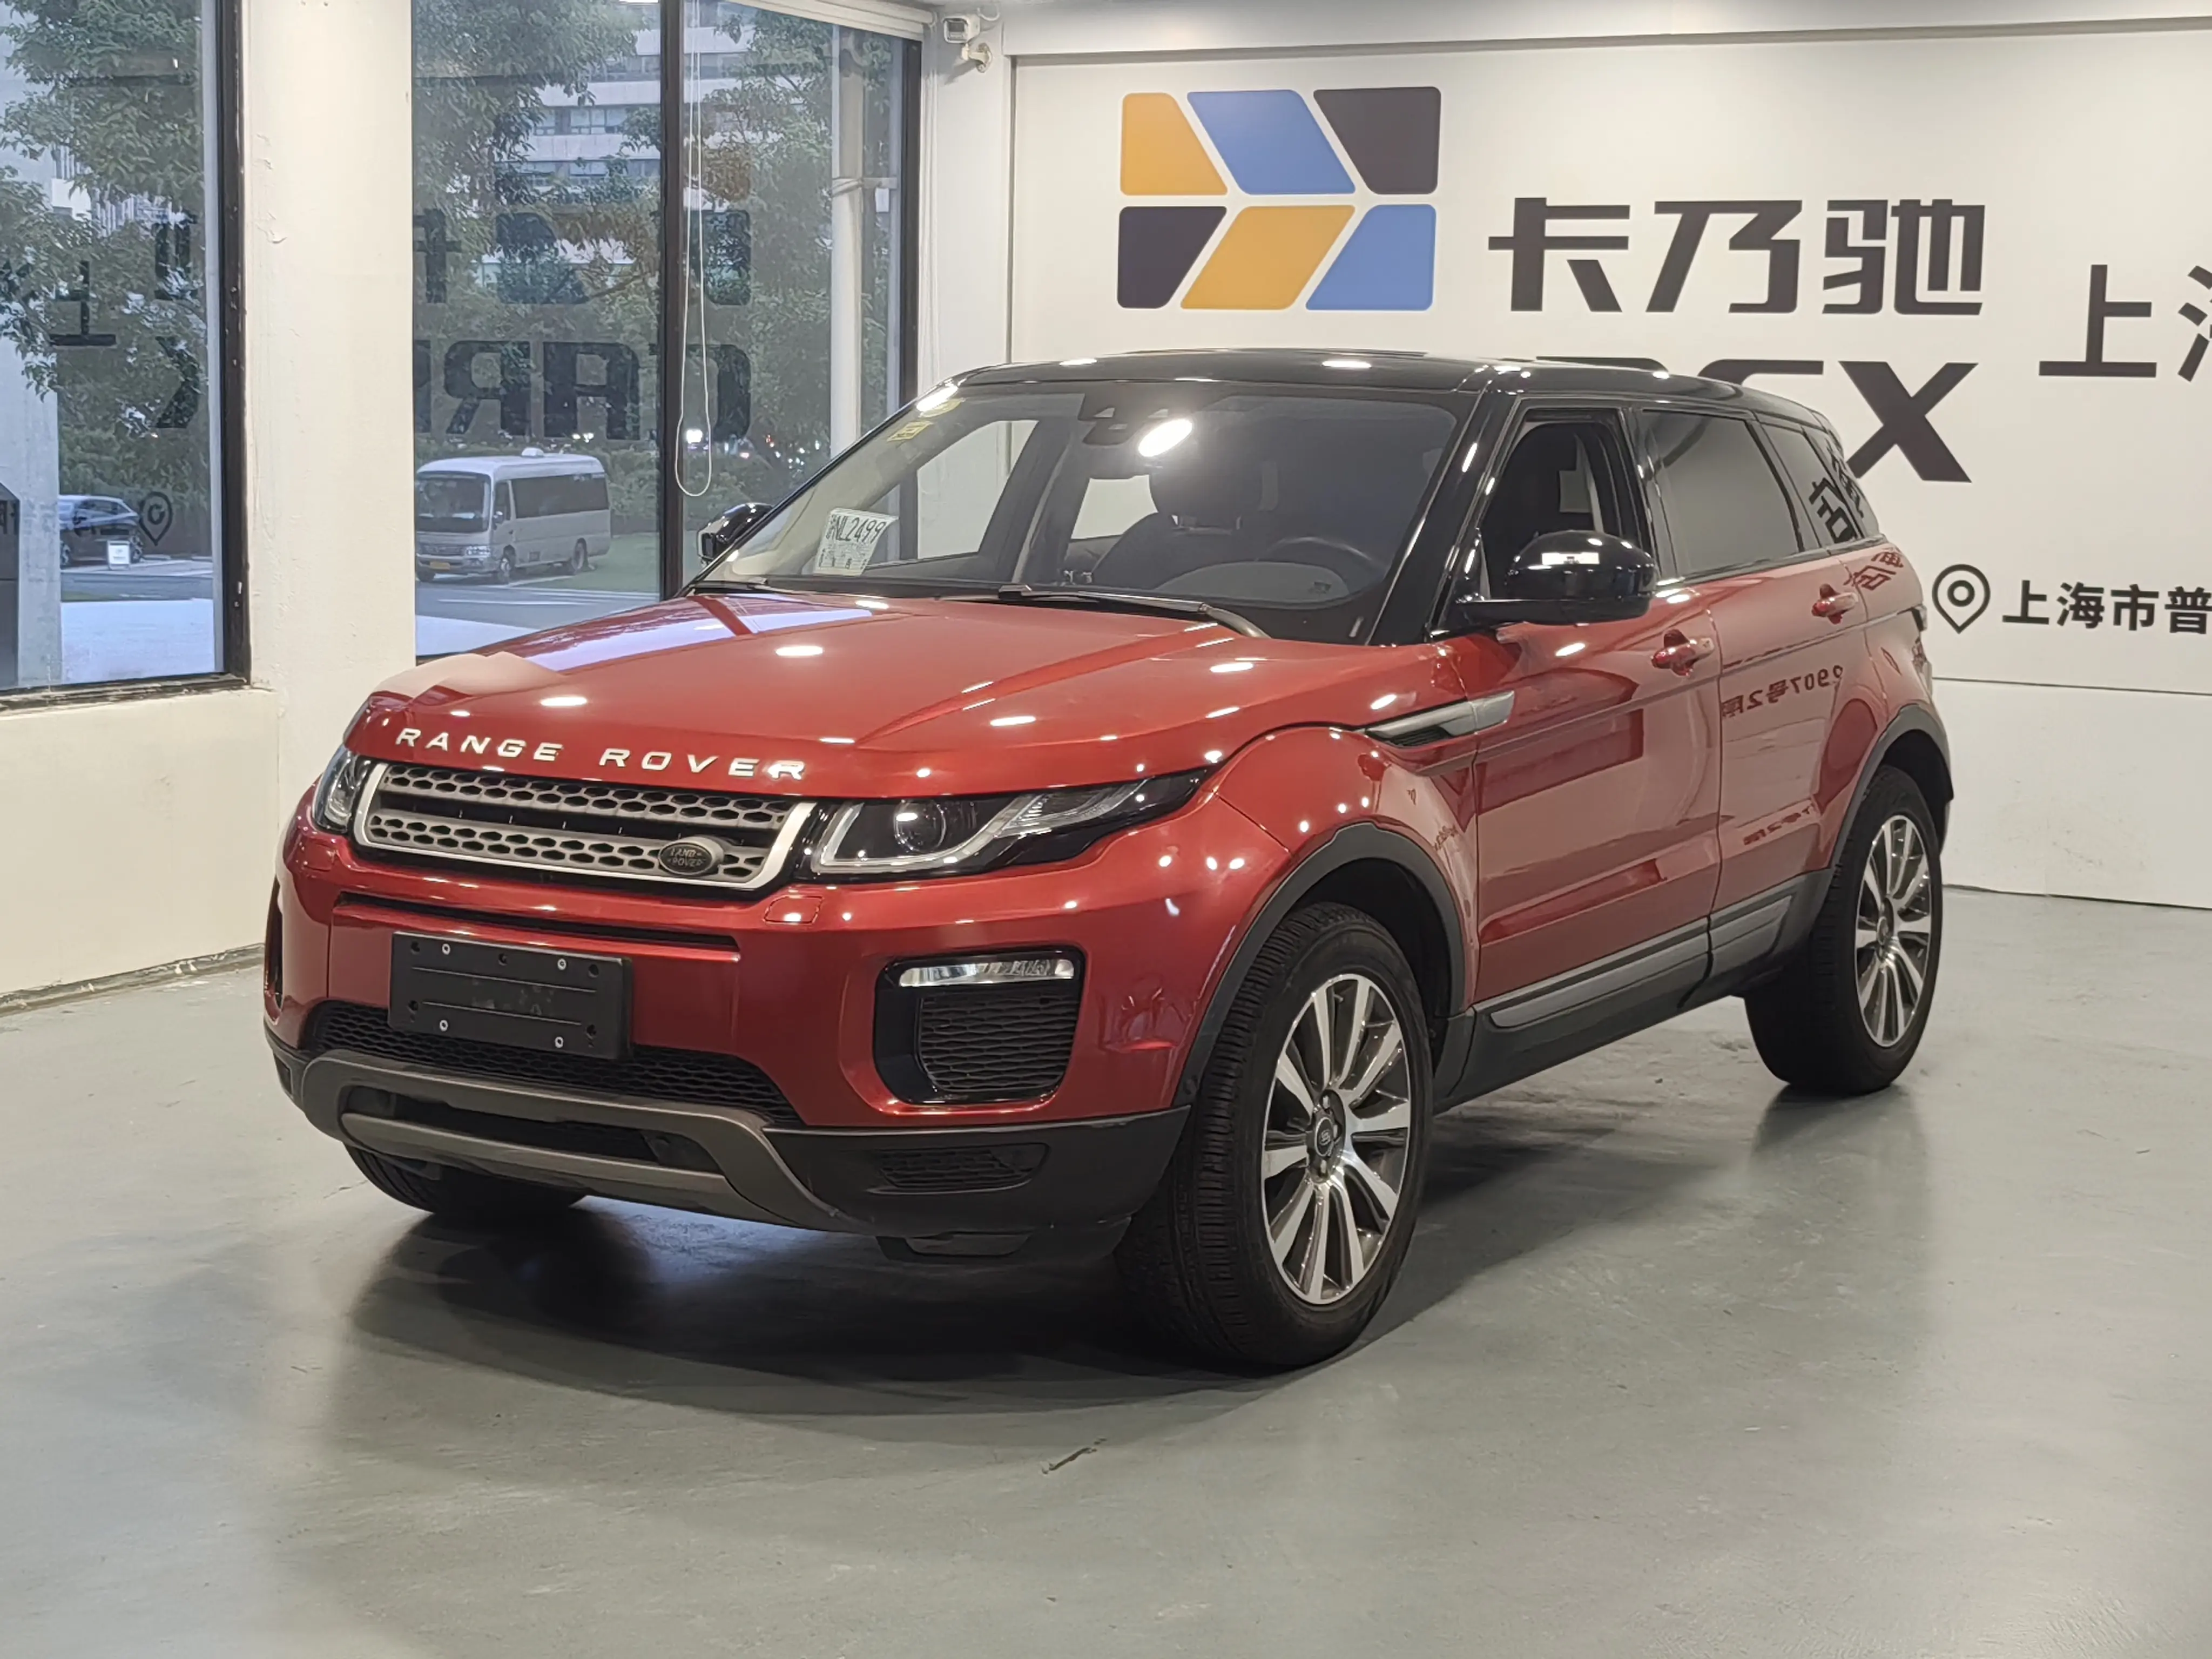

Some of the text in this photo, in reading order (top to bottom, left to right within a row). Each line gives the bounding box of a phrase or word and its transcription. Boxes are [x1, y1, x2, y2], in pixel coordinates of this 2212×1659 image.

[1489, 198, 1985, 315] 卡乃驰
[2002, 579, 2212, 635] 上海市普
[395, 727, 807, 780] RANGE ROVER
